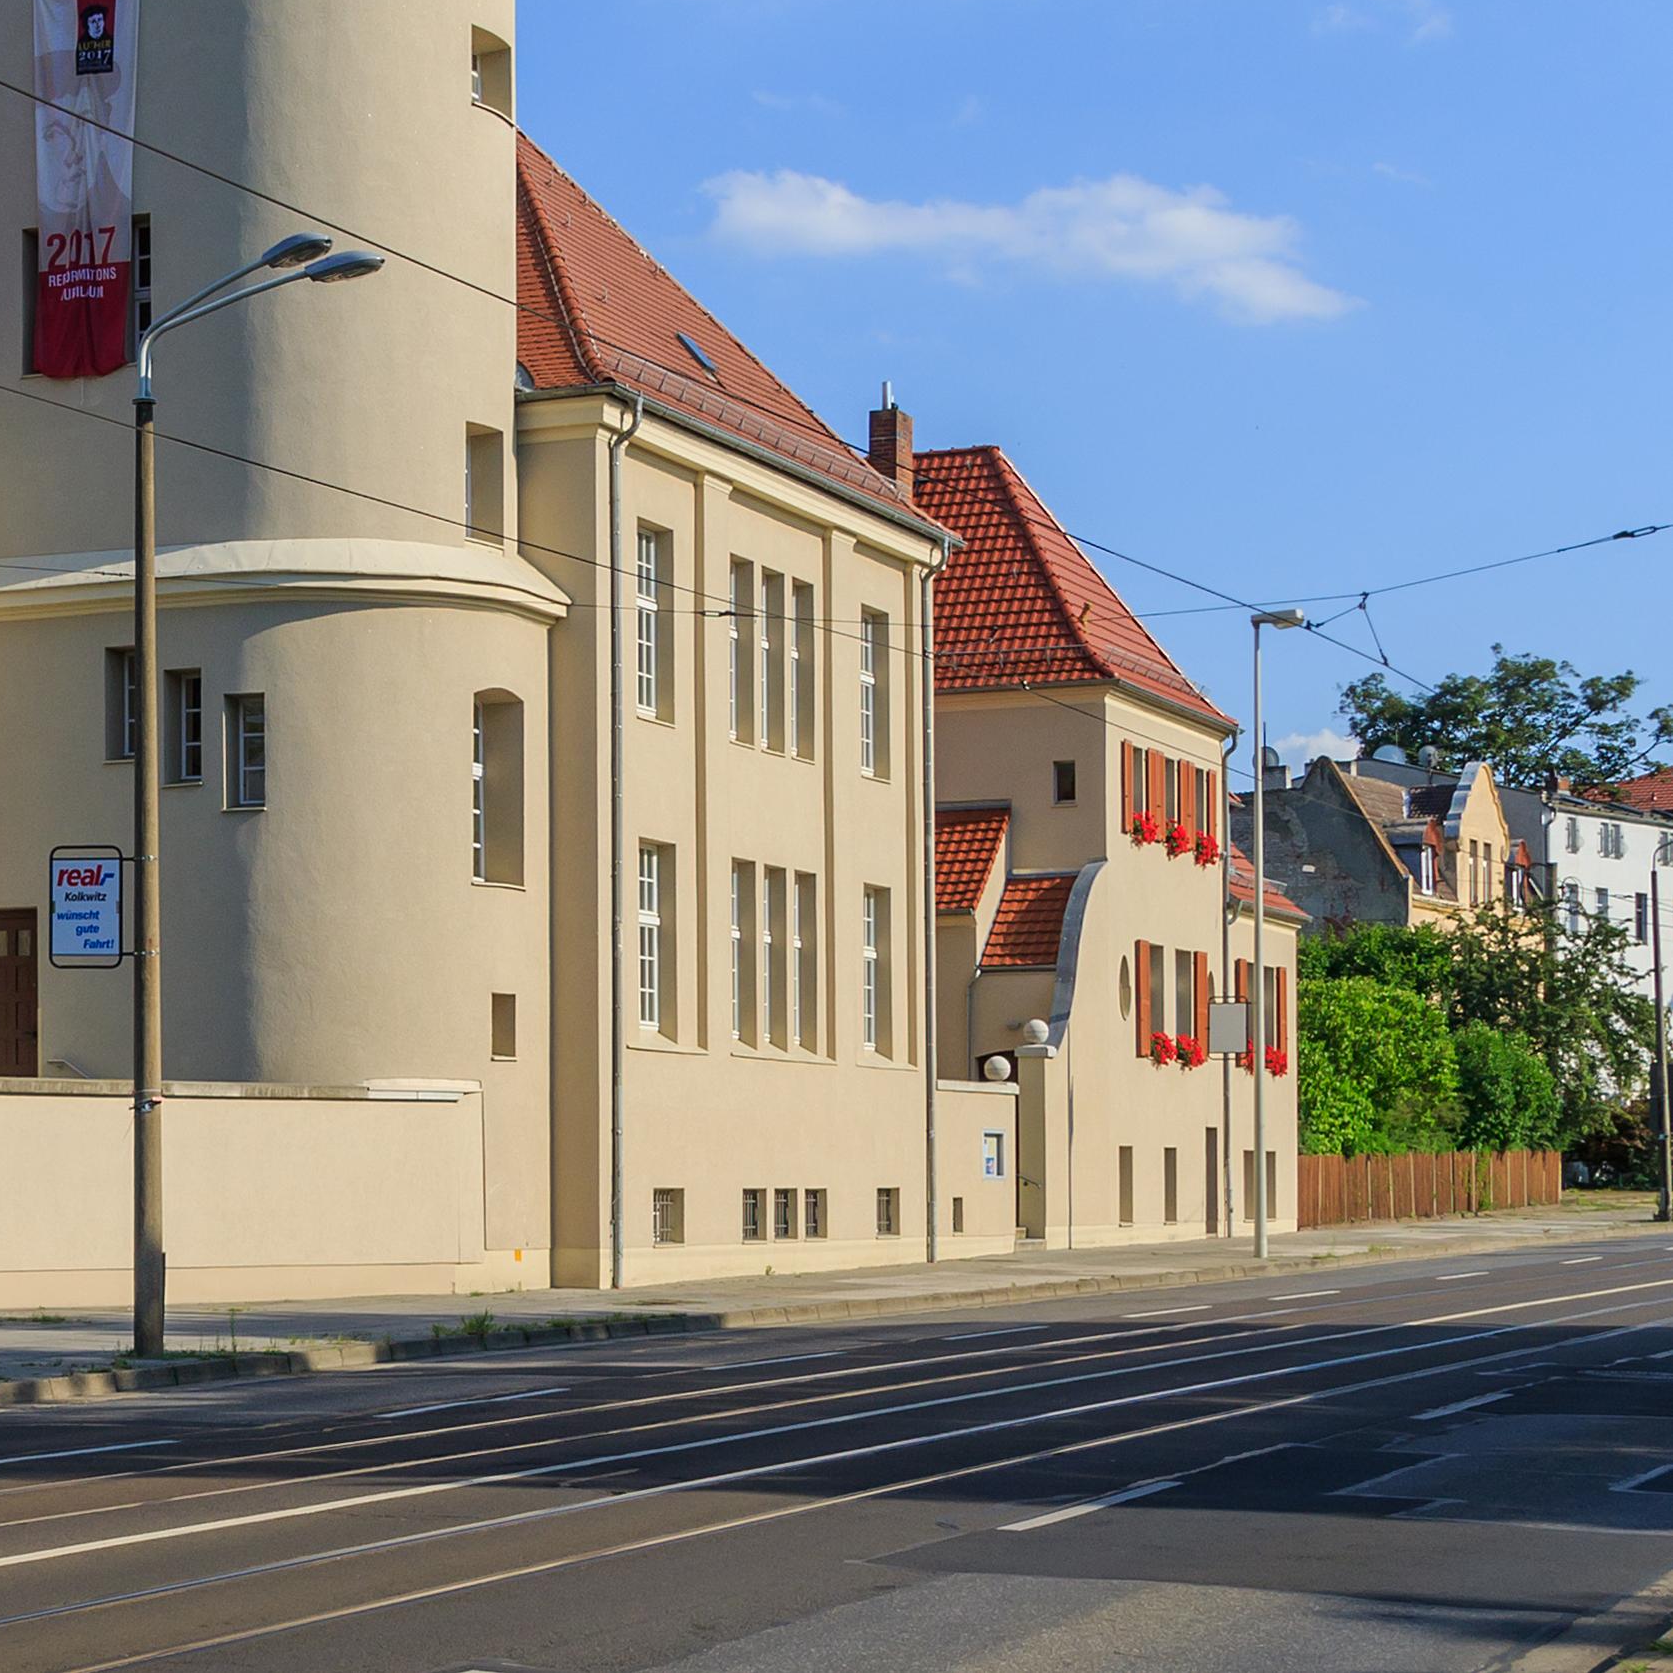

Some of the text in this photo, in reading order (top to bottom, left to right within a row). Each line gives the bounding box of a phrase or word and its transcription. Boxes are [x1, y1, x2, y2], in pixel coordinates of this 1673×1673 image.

[79, 49, 111, 65] 2017
[47, 226, 116, 268] 2017
[64, 891, 107, 902] Kolkwitz
[57, 910, 100, 920] wünscht
[76, 925, 99, 936] gute
[83, 939, 114, 949] Fahrt!
